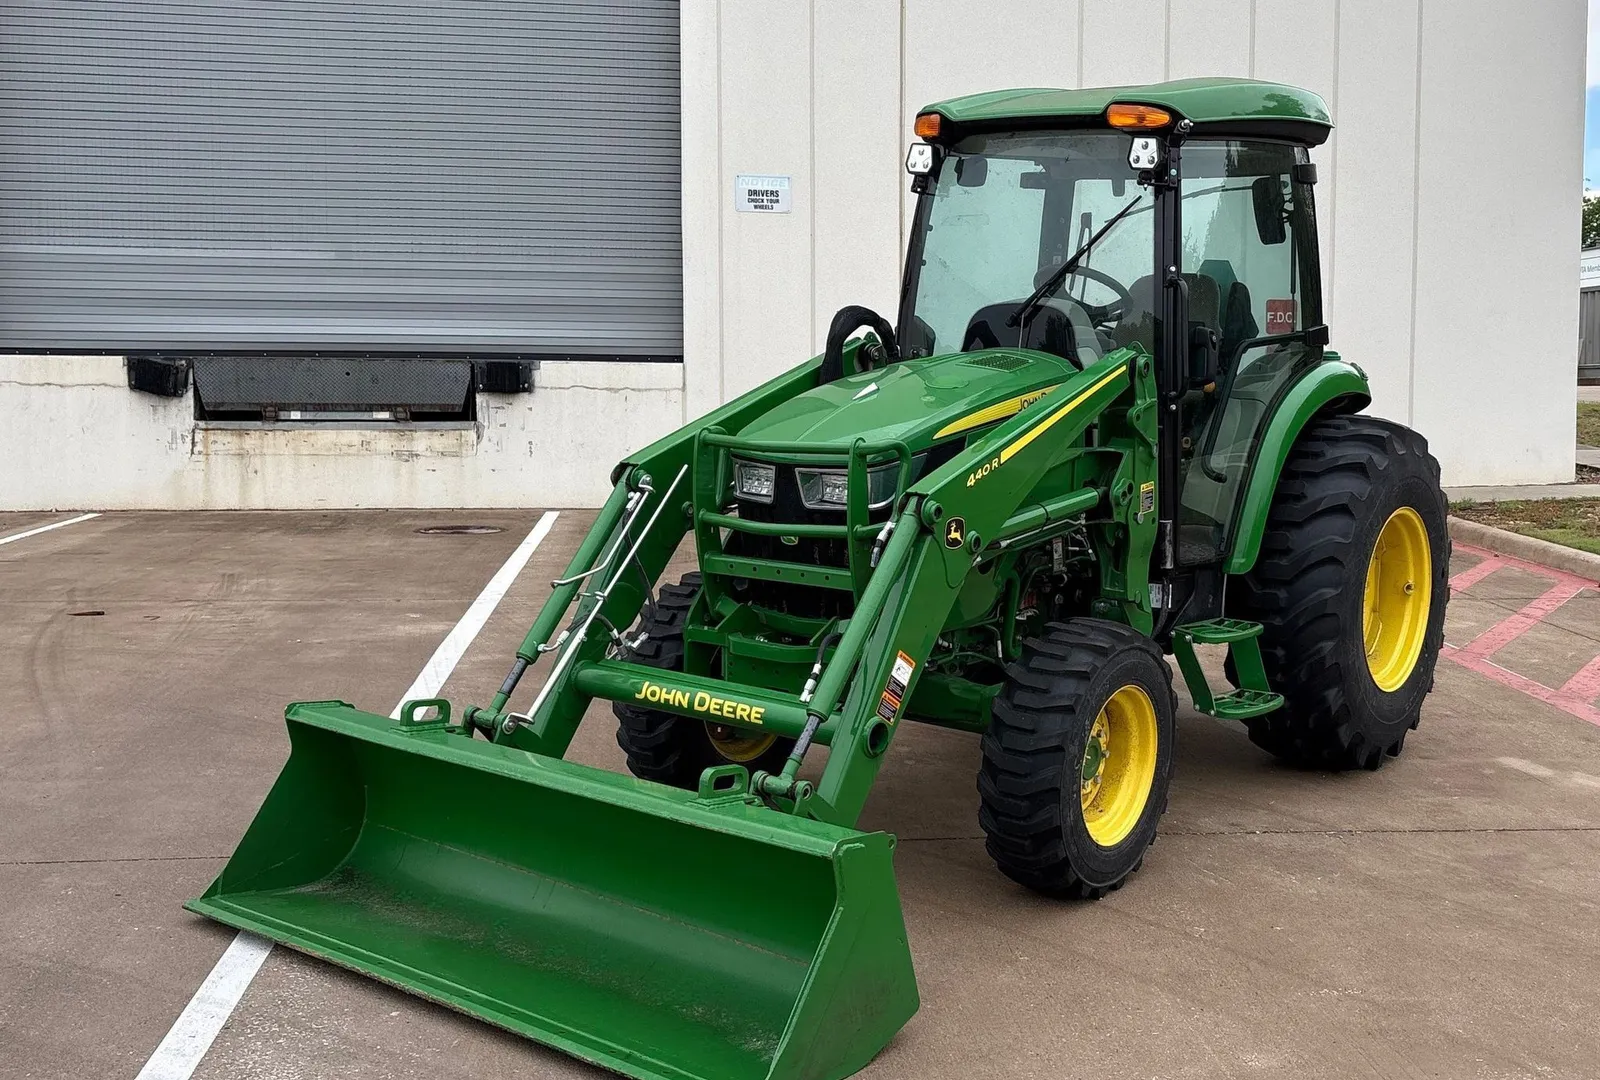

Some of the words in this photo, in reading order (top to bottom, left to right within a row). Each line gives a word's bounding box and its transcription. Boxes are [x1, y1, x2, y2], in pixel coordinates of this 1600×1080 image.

[747, 189, 779, 198] DRIVERS
[634, 681, 690, 709] JOHN
[693, 691, 765, 725] DEERE
